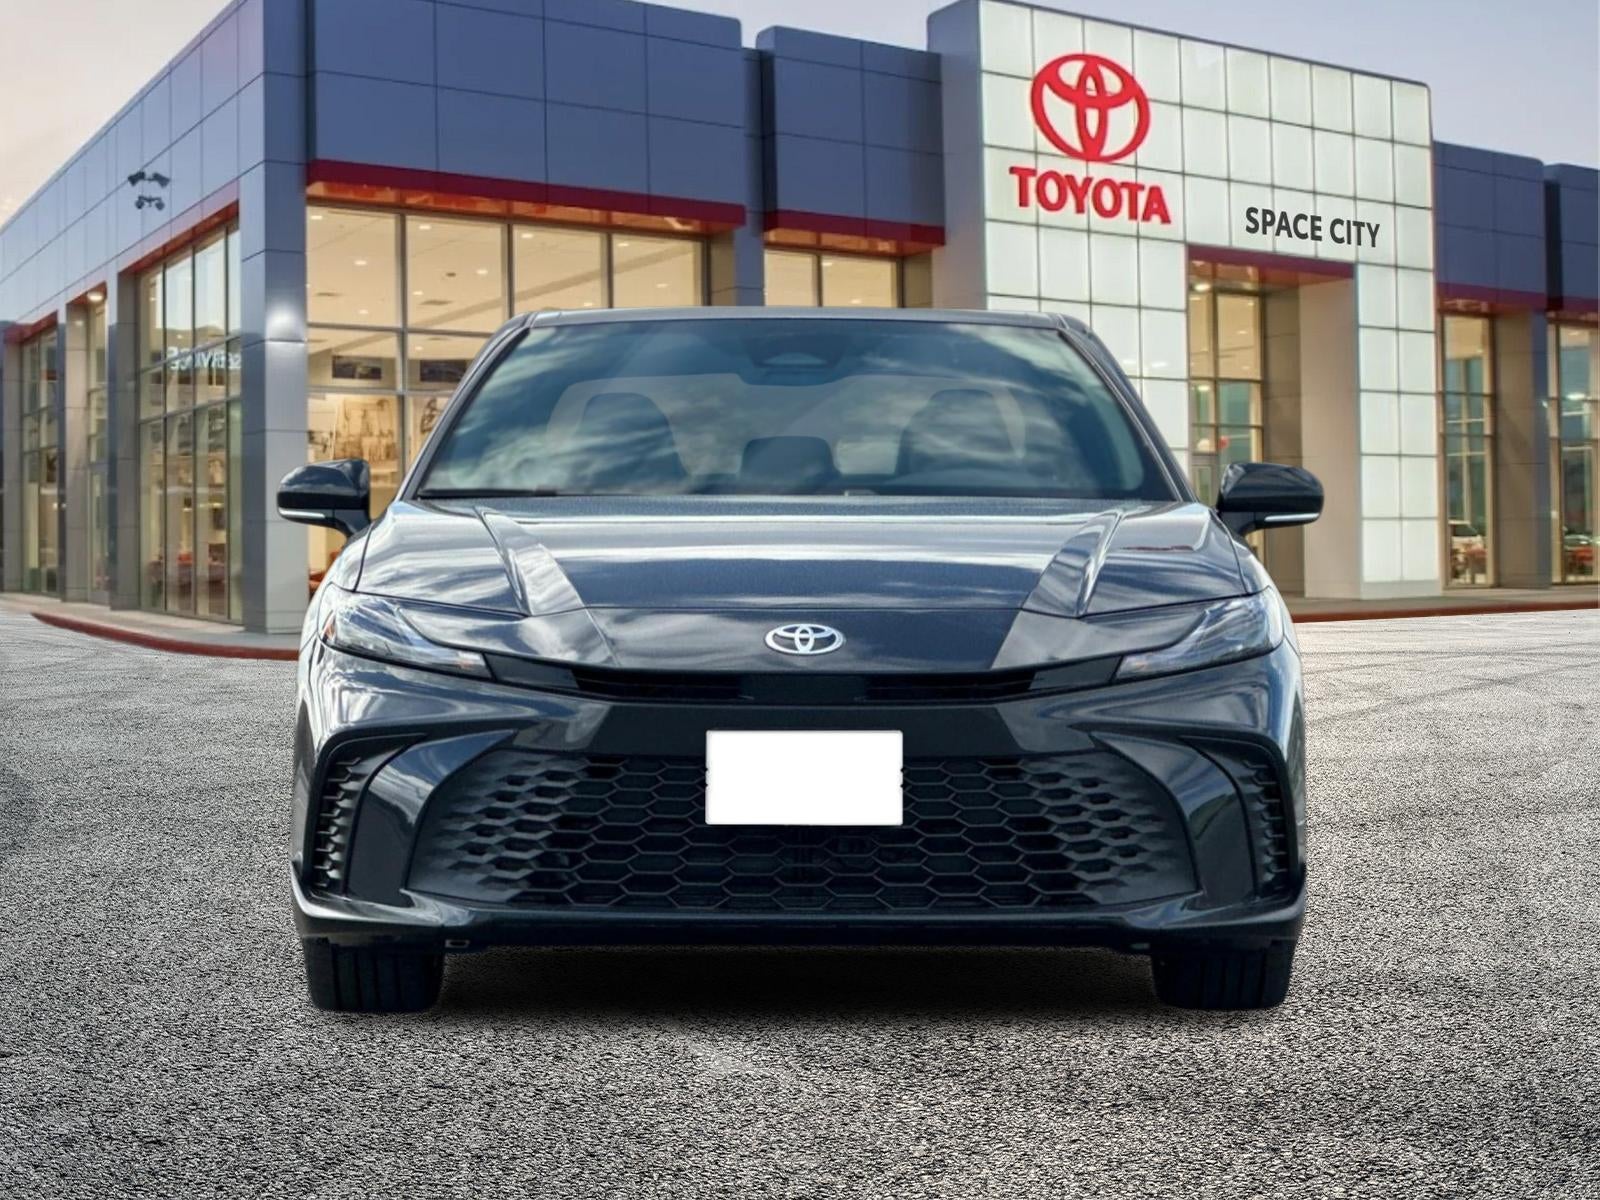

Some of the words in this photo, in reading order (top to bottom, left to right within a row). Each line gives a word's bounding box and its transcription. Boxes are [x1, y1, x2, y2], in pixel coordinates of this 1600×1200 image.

[1009, 166, 1171, 224] TOYOTA
[1246, 206, 1322, 241] SPACE
[1329, 218, 1380, 248] CITY
